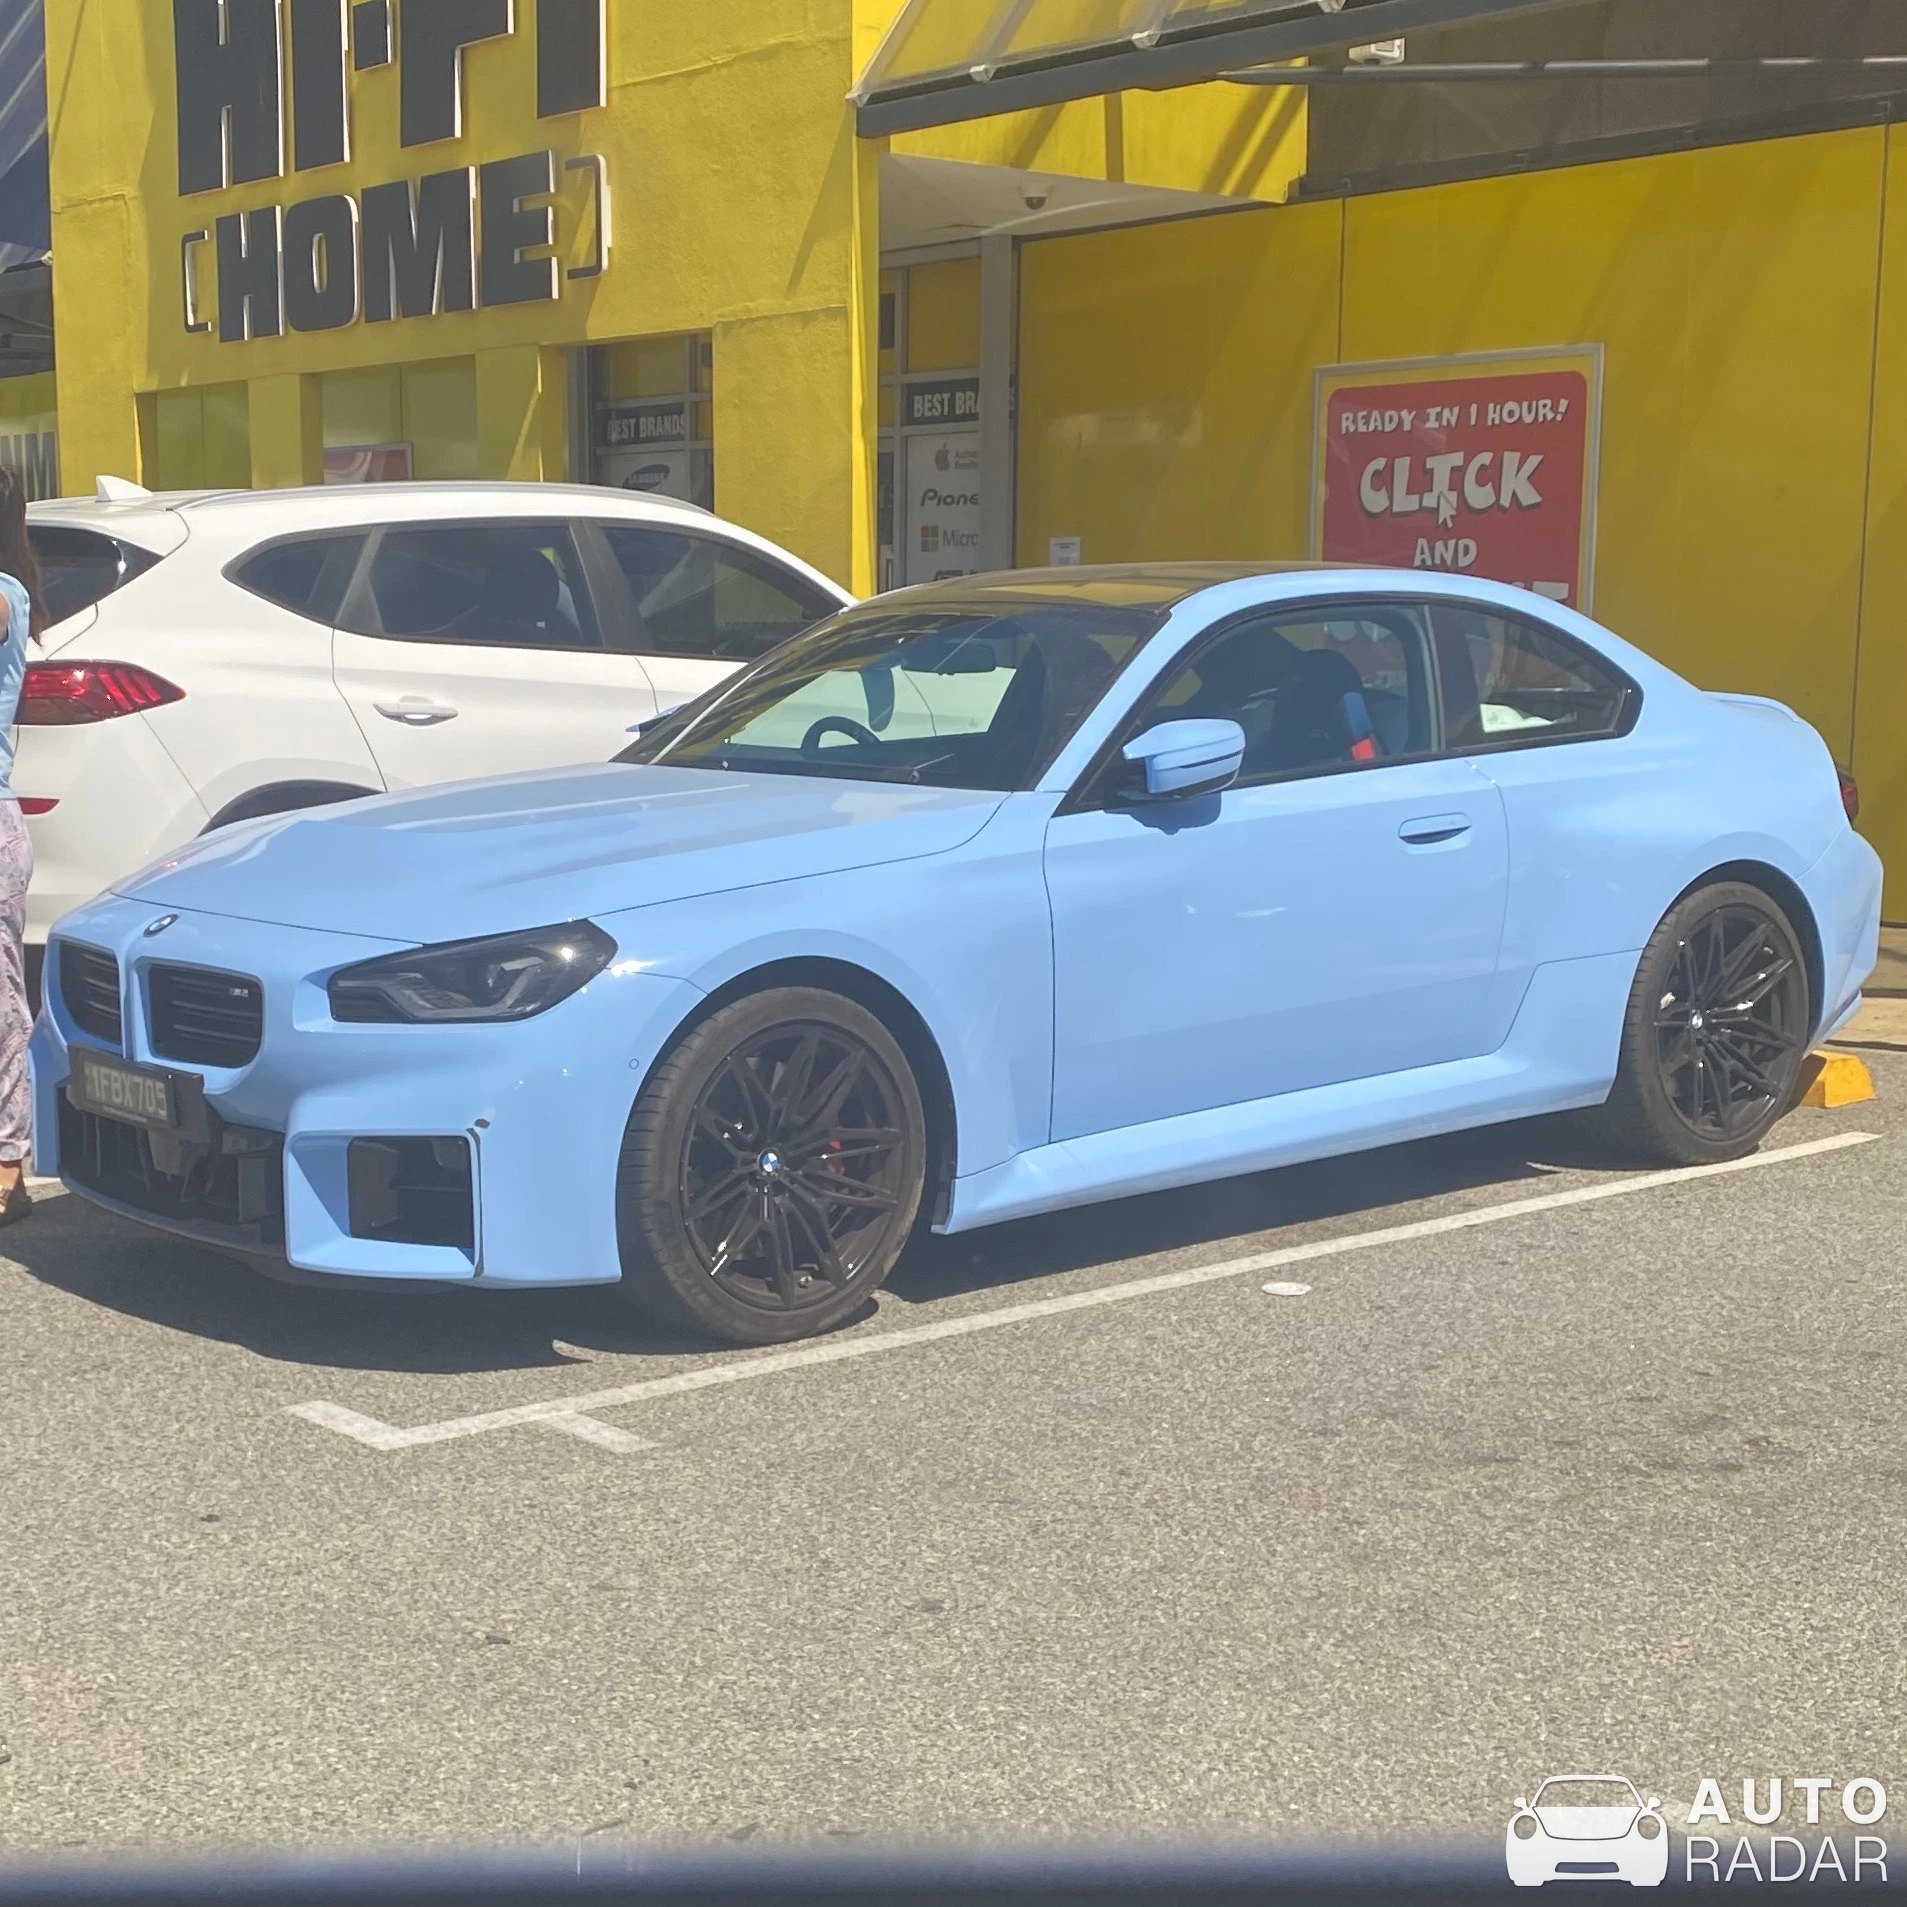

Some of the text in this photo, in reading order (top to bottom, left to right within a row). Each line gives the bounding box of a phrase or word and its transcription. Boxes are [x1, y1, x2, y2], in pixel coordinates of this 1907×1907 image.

[914, 393, 951, 418] BEST
[1341, 409, 1416, 435] READY
[1424, 406, 1460, 429] IN
[1486, 398, 1569, 426] HOUR!
[640, 413, 686, 438] BRANDS
[1359, 450, 1545, 515] CLICK
[1412, 537, 1478, 568] AND
